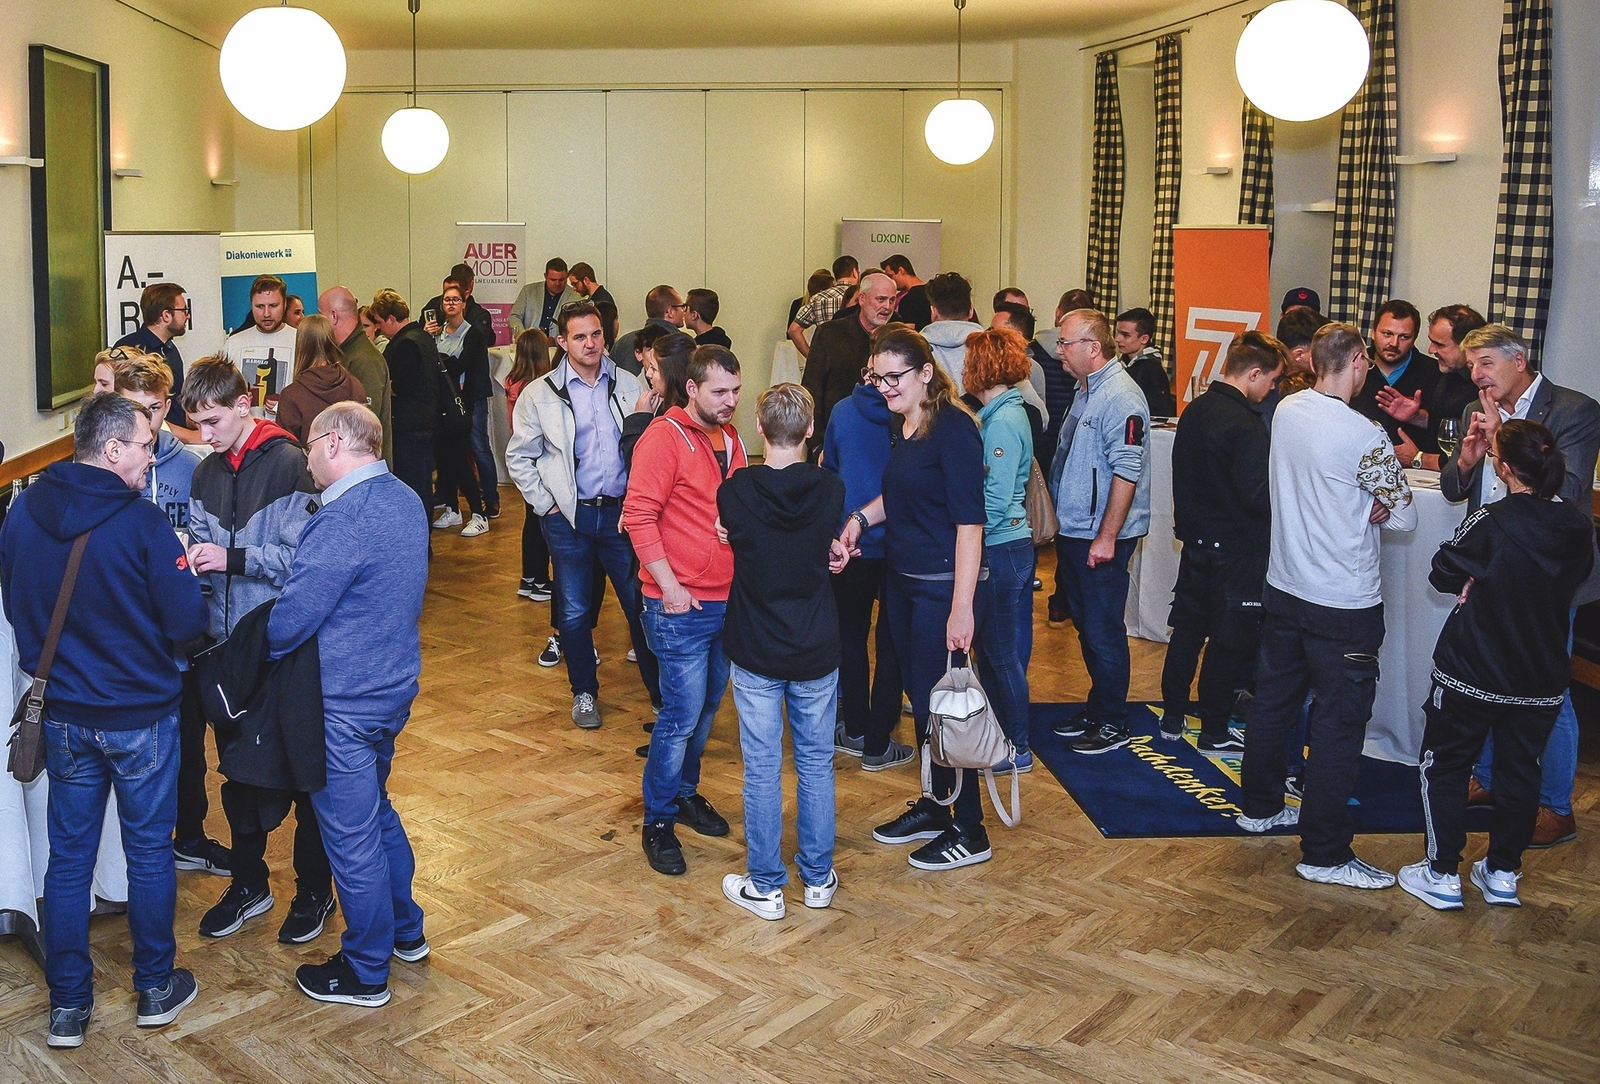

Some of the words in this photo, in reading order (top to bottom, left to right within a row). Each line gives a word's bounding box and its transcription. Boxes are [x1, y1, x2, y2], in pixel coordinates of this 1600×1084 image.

[870, 233, 911, 244] LOXONE
[226, 249, 284, 260] Diakoniewerk
[464, 242, 518, 260] AUER
[463, 260, 518, 277] MODE
[146, 480, 179, 498] SPPLY
